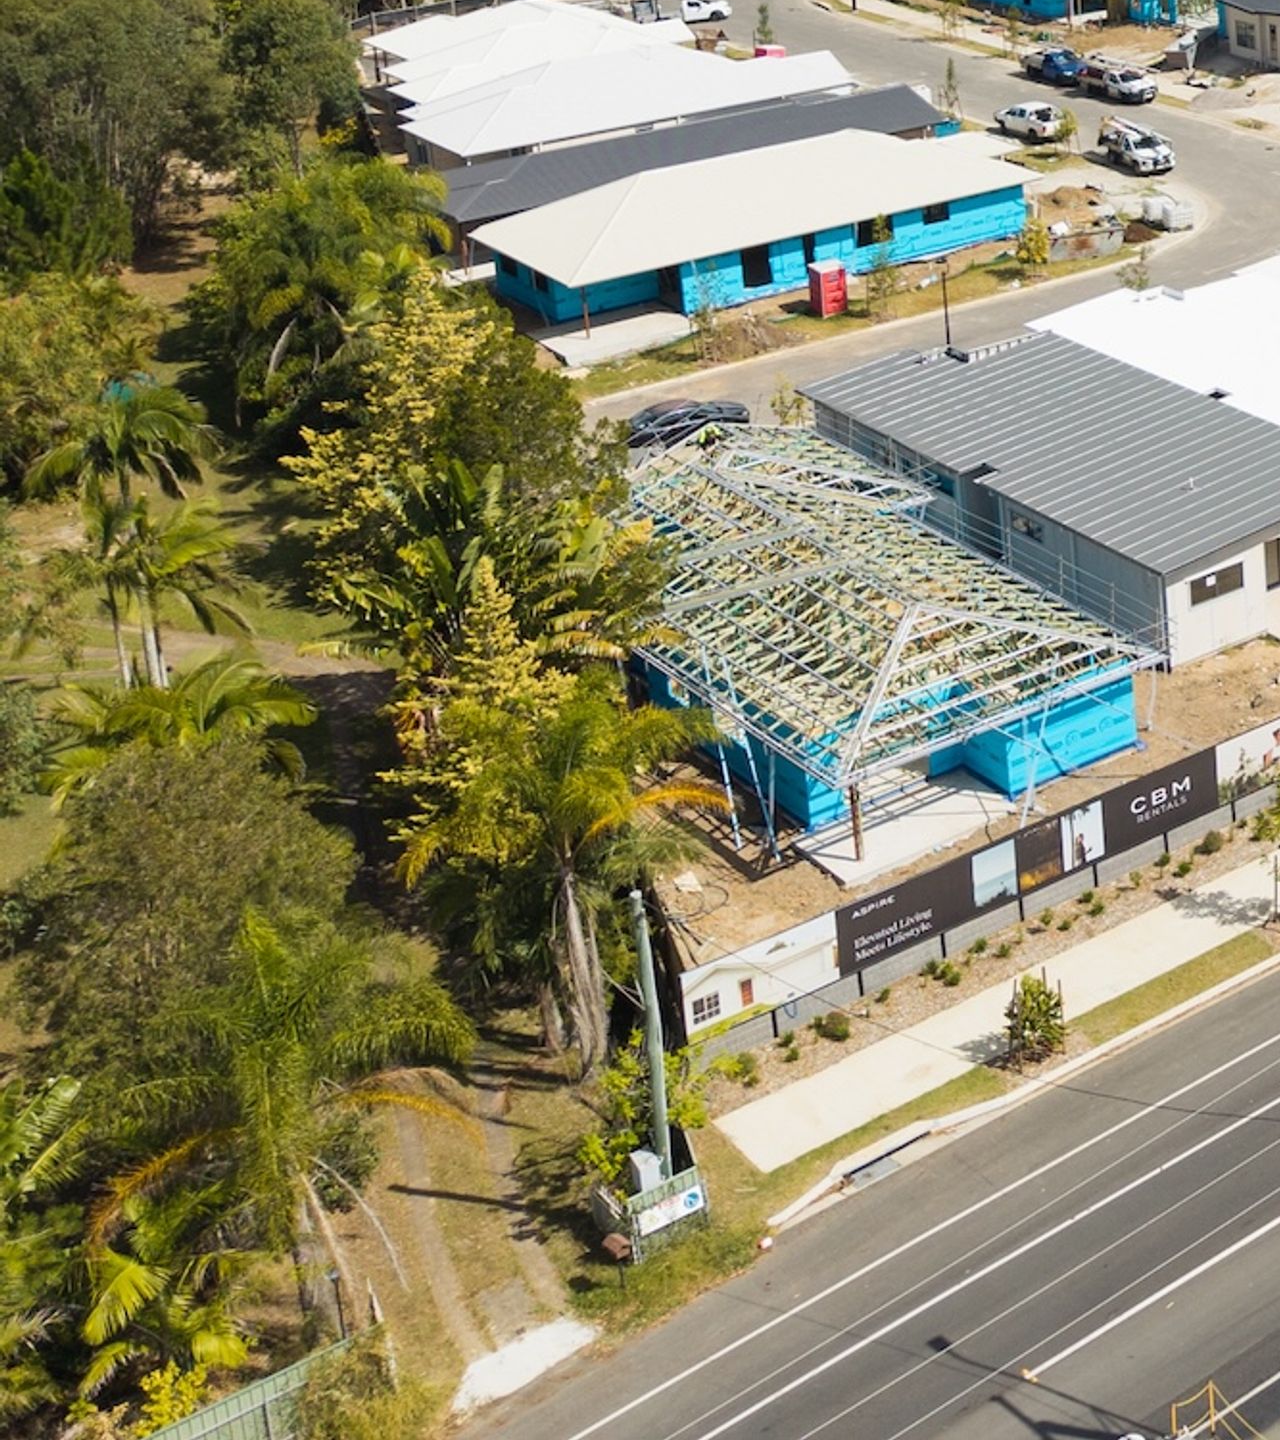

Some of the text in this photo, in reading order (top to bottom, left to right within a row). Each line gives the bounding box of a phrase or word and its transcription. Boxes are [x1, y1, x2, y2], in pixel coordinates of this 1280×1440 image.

[1130, 775, 1191, 814] CBM
[1136, 795, 1188, 823] RENTALS
[851, 894, 896, 920] ASPIRE
